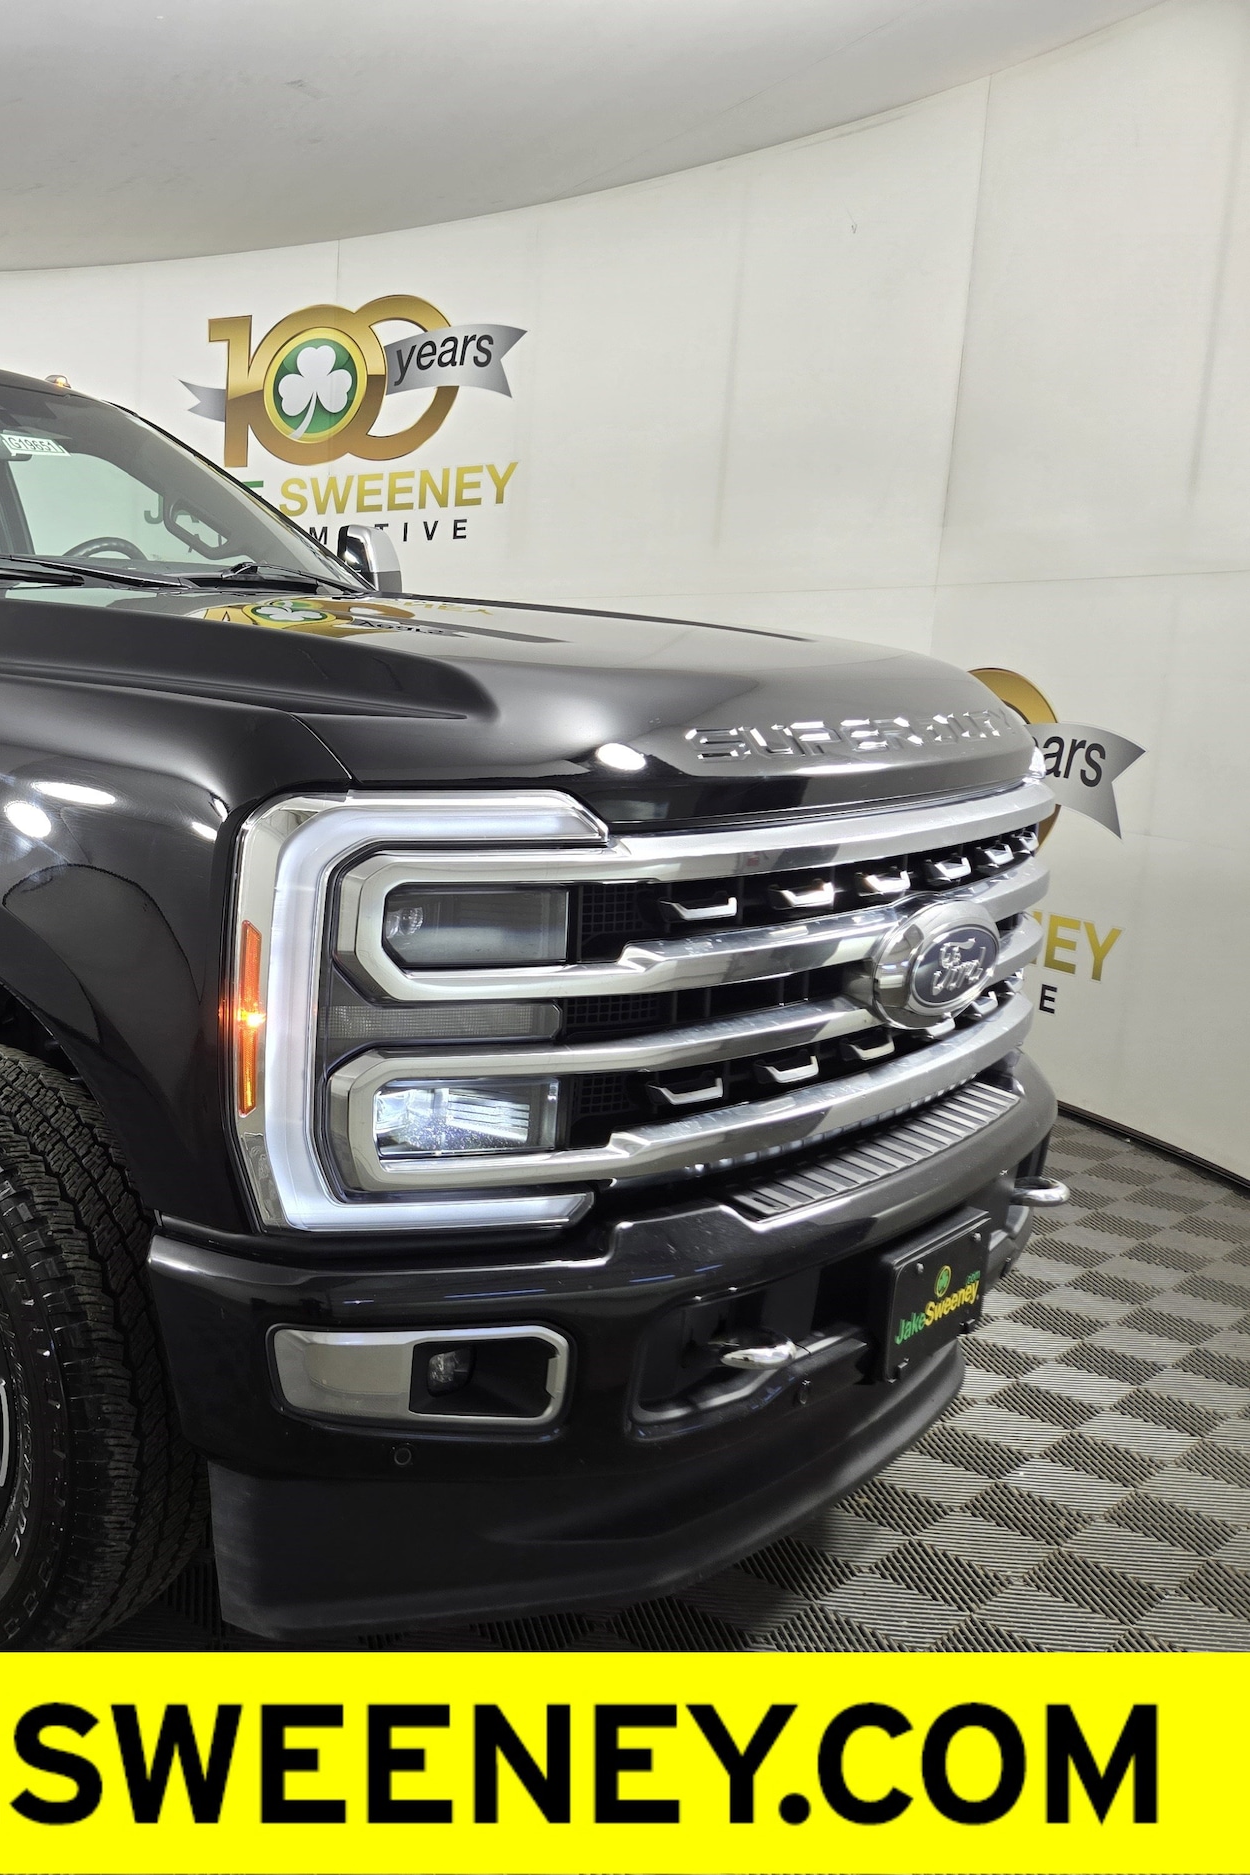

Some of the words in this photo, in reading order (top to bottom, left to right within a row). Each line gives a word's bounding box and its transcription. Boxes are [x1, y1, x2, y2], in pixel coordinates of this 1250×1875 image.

[207, 294, 460, 468] 100
[393, 332, 495, 387] years
[8, 437, 60, 453] G19651
[279, 461, 522, 517] SWEENEY
[685, 716, 924, 760] SUPER
[1031, 734, 1107, 788] ars
[932, 938, 987, 996] Ford
